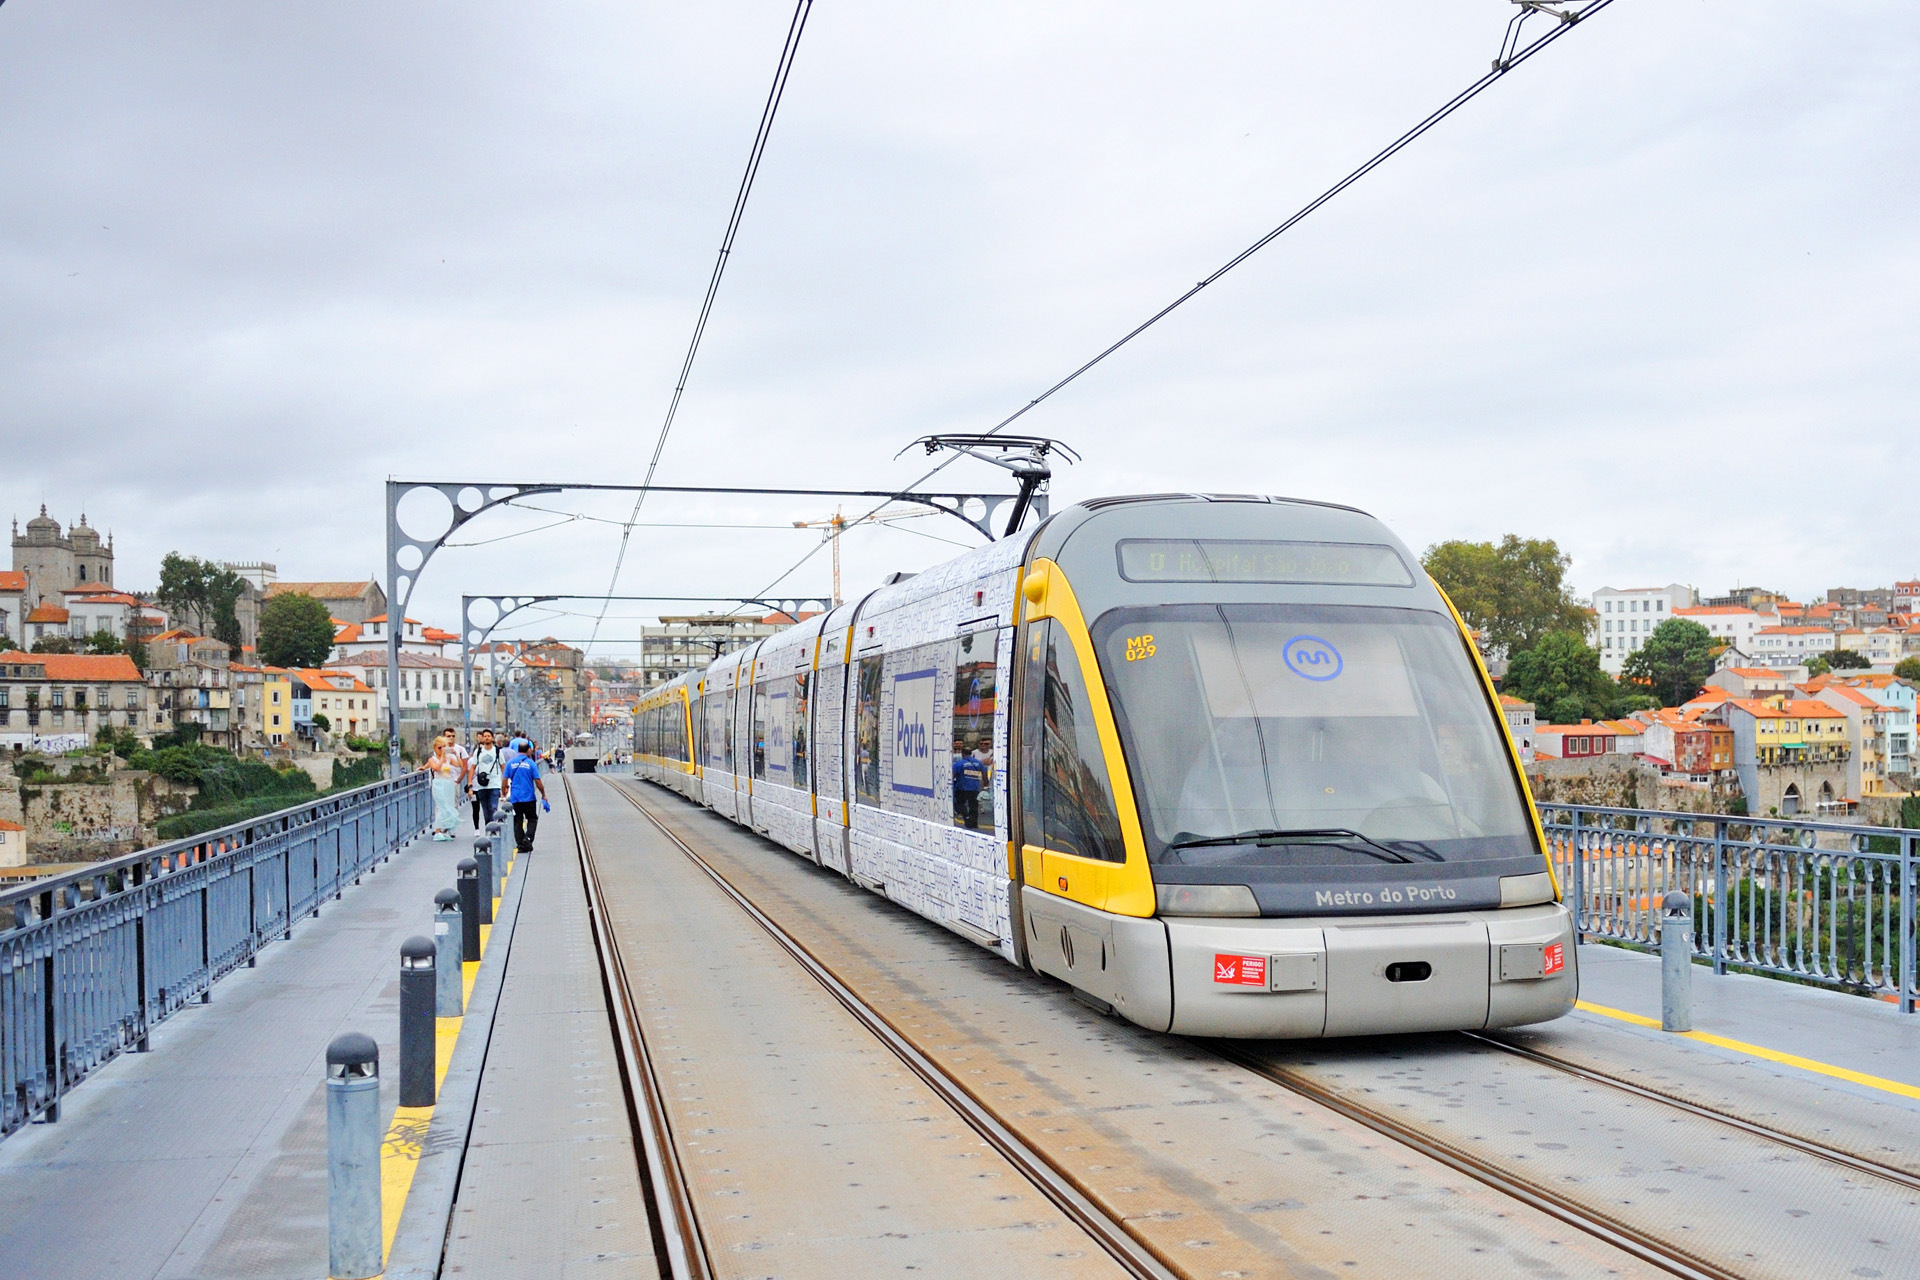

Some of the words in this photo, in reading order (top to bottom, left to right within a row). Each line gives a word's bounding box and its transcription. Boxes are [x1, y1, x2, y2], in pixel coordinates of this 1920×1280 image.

[1126, 634, 1155, 650] MP
[1125, 645, 1157, 662] 029
[896, 707, 928, 759] Porto.
[1315, 889, 1373, 907] Metro
[1380, 887, 1403, 903] do
[1405, 885, 1457, 902] Porto
[1242, 960, 1264, 968] PERIGO!
